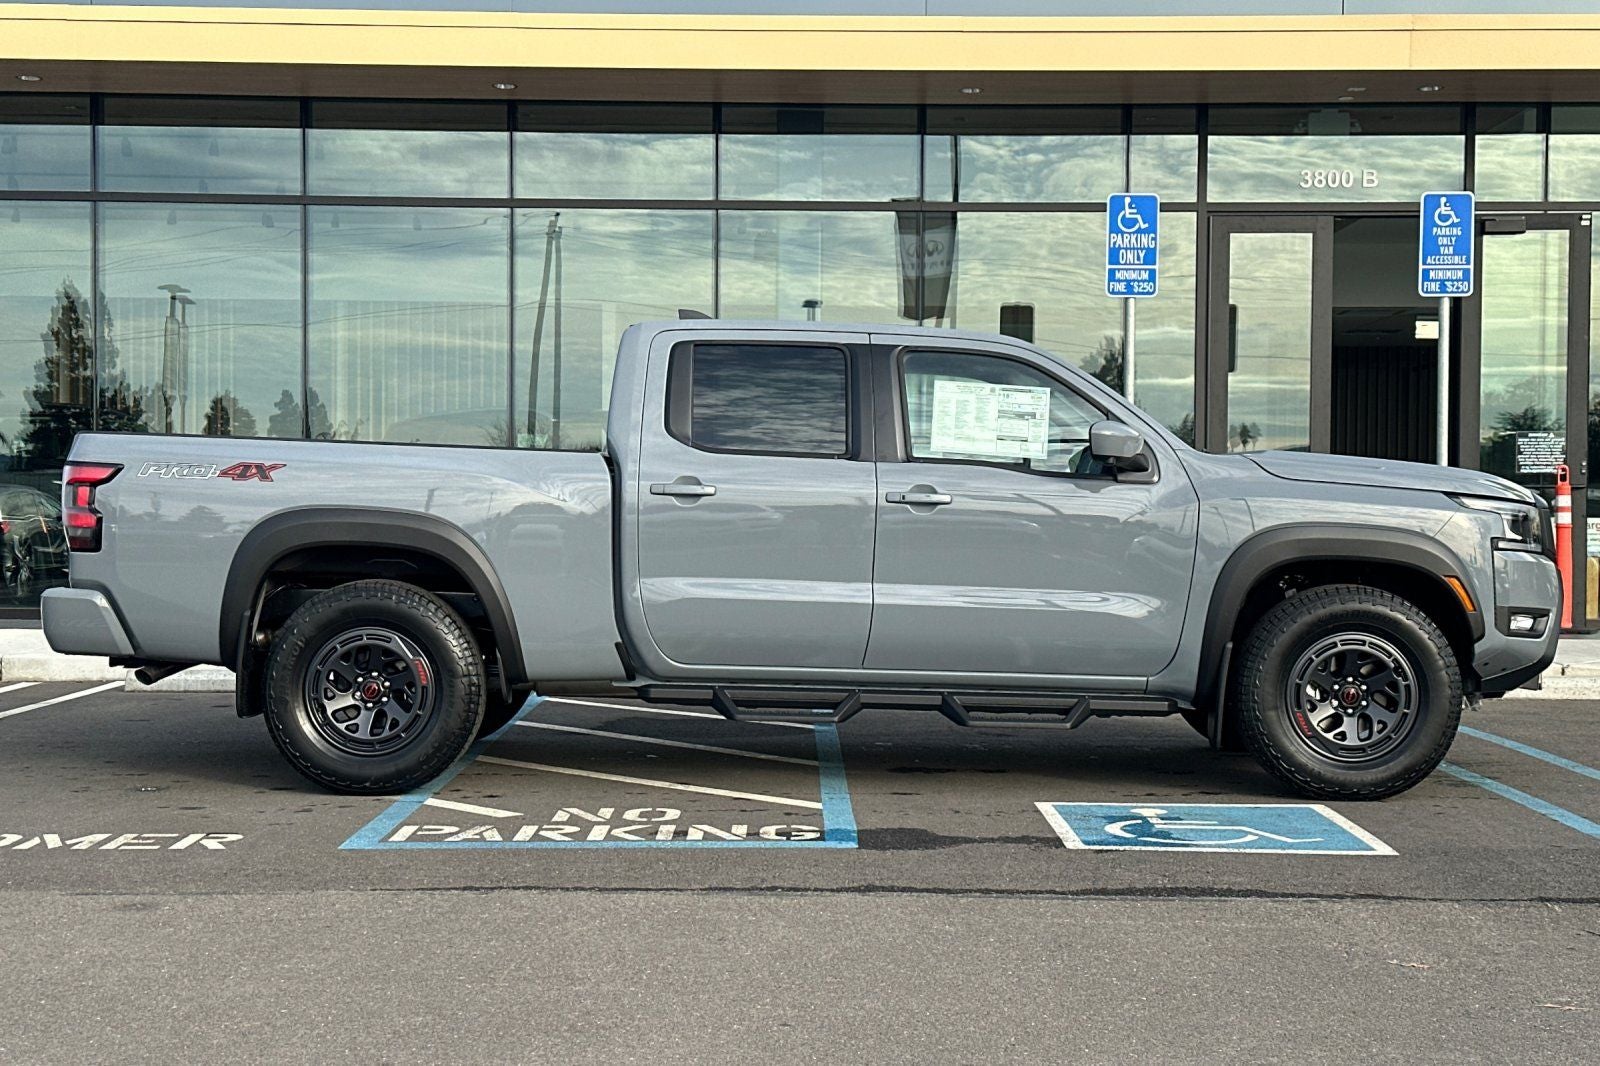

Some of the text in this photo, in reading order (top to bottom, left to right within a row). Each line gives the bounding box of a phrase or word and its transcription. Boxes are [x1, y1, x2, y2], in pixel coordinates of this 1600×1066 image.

[1299, 169, 1379, 188] 3800 B
[1432, 227, 1462, 236] PARKING
[1110, 233, 1156, 248] PARKING
[1437, 236, 1456, 246] ONLY
[1119, 249, 1146, 264] ONLY
[1439, 246, 1454, 255] VAN
[1426, 255, 1467, 265] ACCESSIBLE
[1115, 269, 1149, 280] MINIMUM
[1429, 269, 1463, 280] MINIMUM
[1109, 281, 1154, 293] FINE $250
[1423, 281, 1469, 293] FINE $250
[550, 807, 682, 822] NO
[388, 823, 822, 842] PARKING
